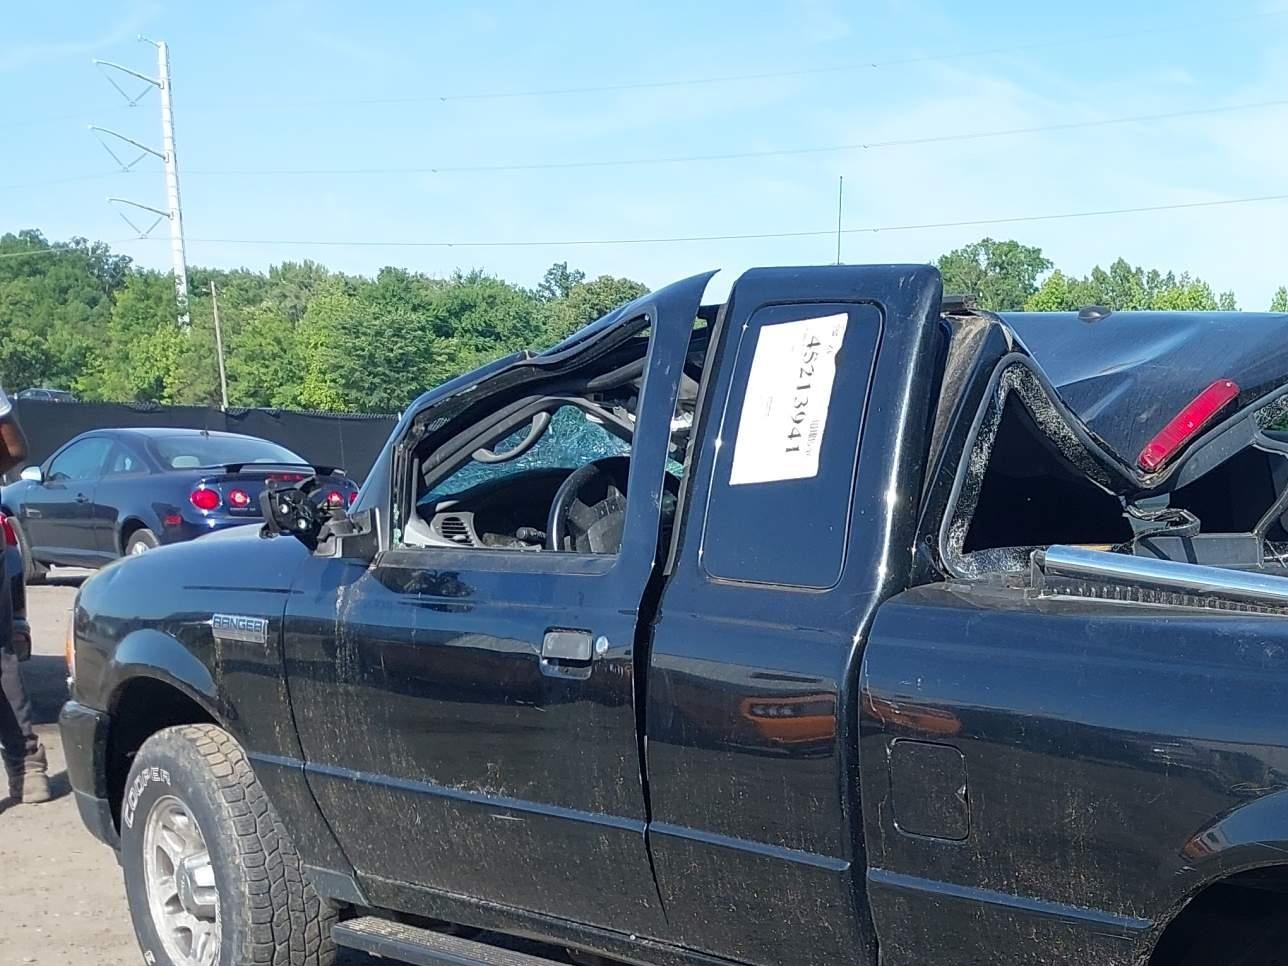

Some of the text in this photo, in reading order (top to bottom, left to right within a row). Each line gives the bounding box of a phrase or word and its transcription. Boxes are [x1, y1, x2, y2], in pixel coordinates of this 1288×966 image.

[785, 335, 821, 453] 45213941
[213, 616, 262, 632] RANGER
[124, 767, 171, 829] COOPER
